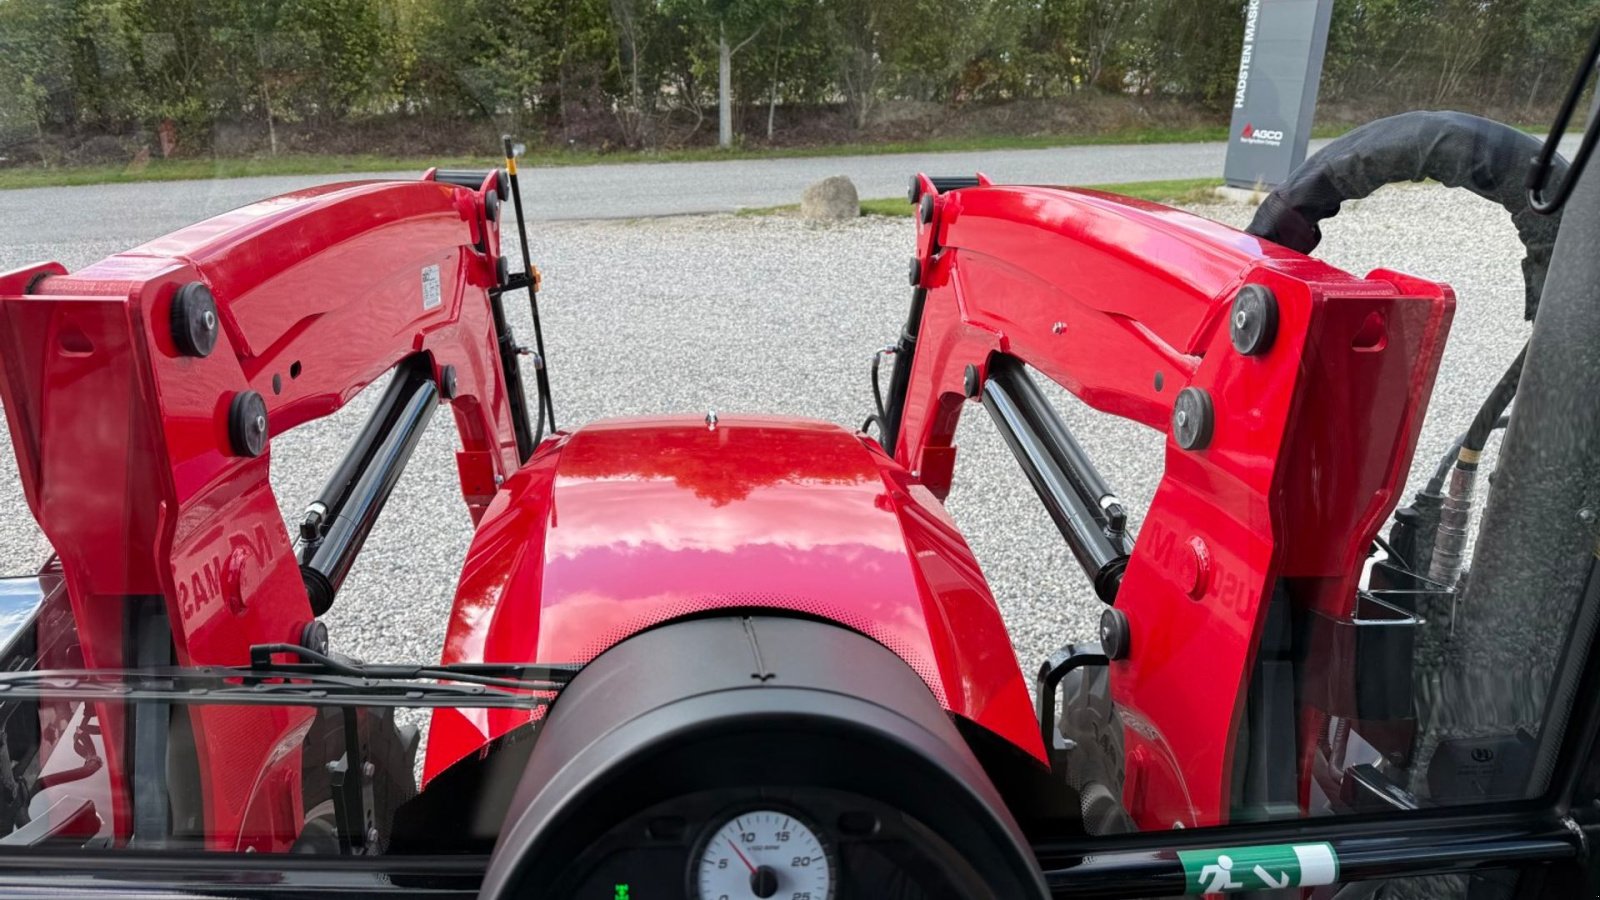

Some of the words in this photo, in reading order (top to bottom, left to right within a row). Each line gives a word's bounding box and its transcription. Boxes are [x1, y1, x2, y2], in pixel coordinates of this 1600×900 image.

[1234, 45, 1252, 108] HADSTEN
[1252, 129, 1283, 141] AGCO
[739, 832, 756, 843] 10
[774, 831, 791, 842] 15
[718, 859, 729, 869] 5
[791, 857, 811, 867] 20
[792, 892, 811, 900] 25
